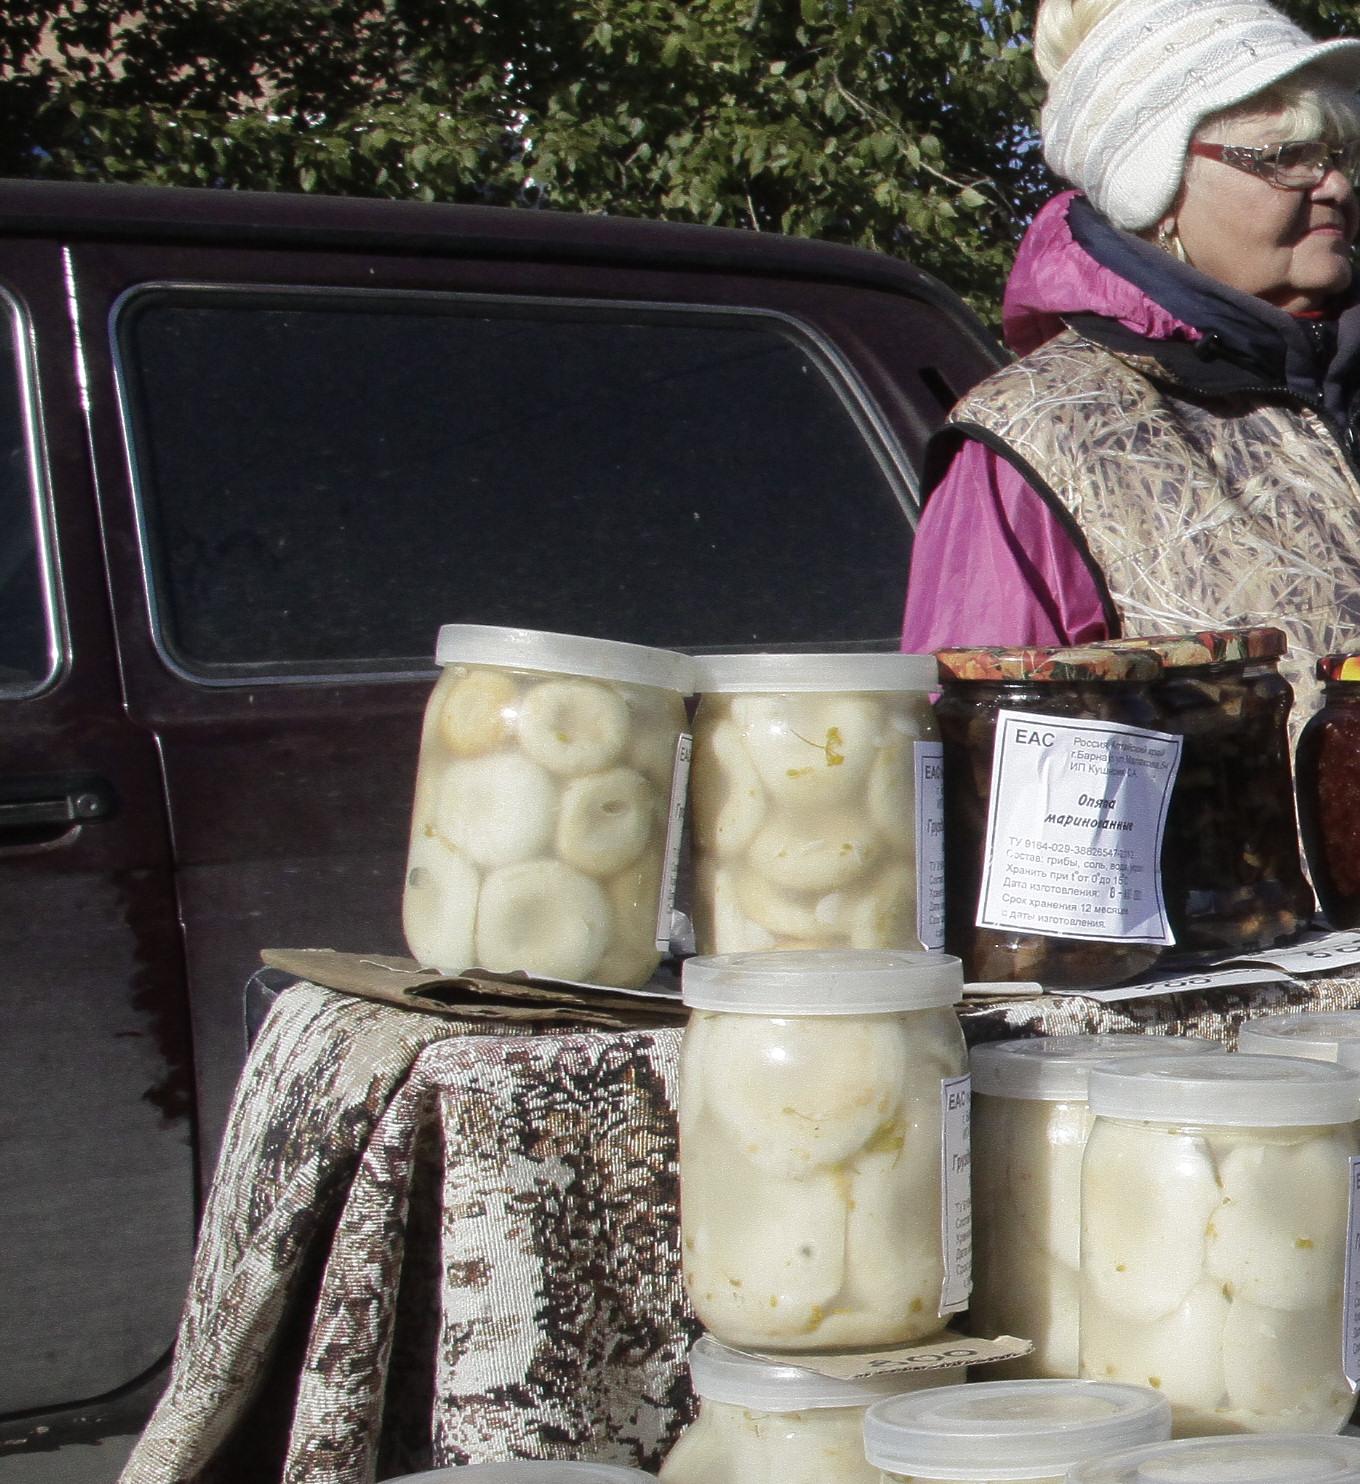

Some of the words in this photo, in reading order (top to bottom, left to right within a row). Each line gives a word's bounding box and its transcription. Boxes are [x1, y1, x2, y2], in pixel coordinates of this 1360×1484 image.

[1015, 728, 1055, 747] EAC
[1070, 764, 1086, 773] ИП
[1009, 837, 1023, 847] ТУ
[1005, 864, 1048, 878] Хранить
[1050, 870, 1069, 882] при
[1099, 876, 1111, 885] до
[1003, 877, 1028, 890] Дата
[1002, 893, 1028, 907] Срок
[1029, 899, 1078, 912] хранения
[1080, 903, 1092, 913] 12
[1009, 911, 1035, 921] даты
